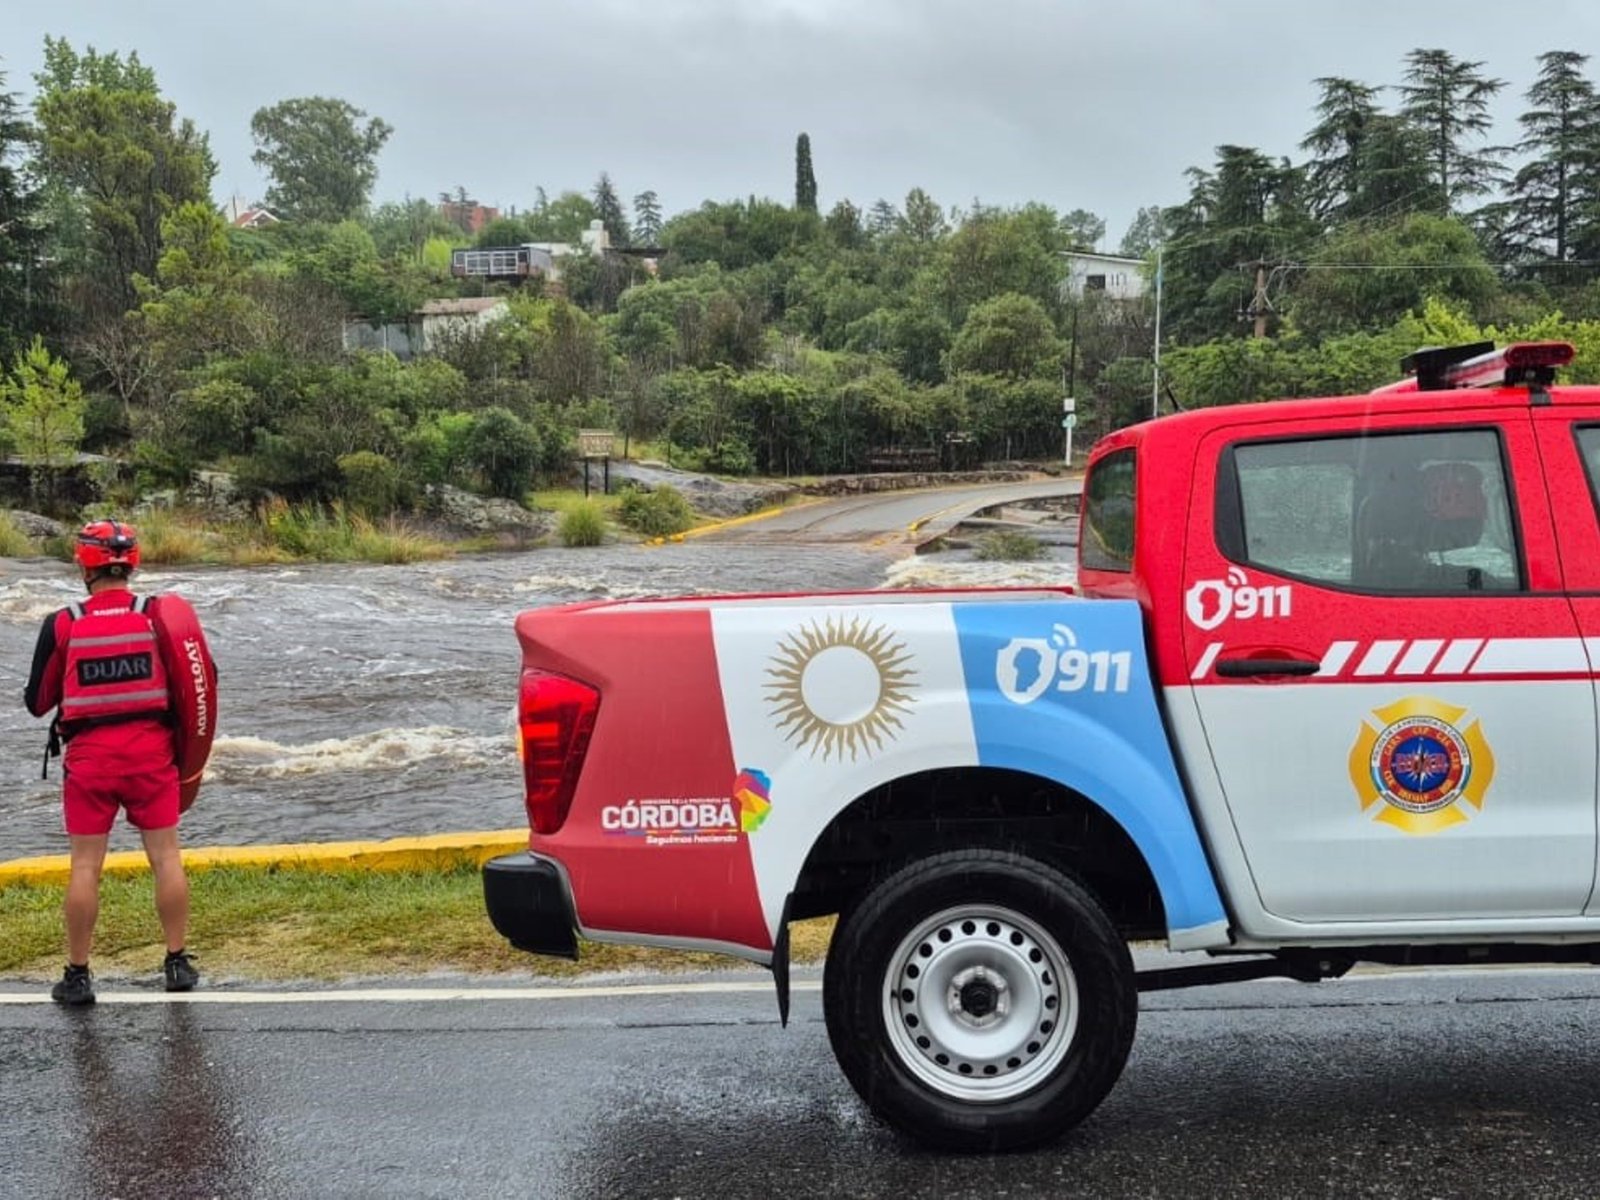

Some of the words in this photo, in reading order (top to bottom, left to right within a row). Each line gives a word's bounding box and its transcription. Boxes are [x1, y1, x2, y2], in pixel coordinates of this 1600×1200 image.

[1234, 585, 1291, 618] 911
[82, 656, 149, 680] DUAR
[1058, 651, 1131, 692] 911
[183, 639, 207, 736] AQUAFLOAT
[602, 800, 737, 829] CÓRDOBA
